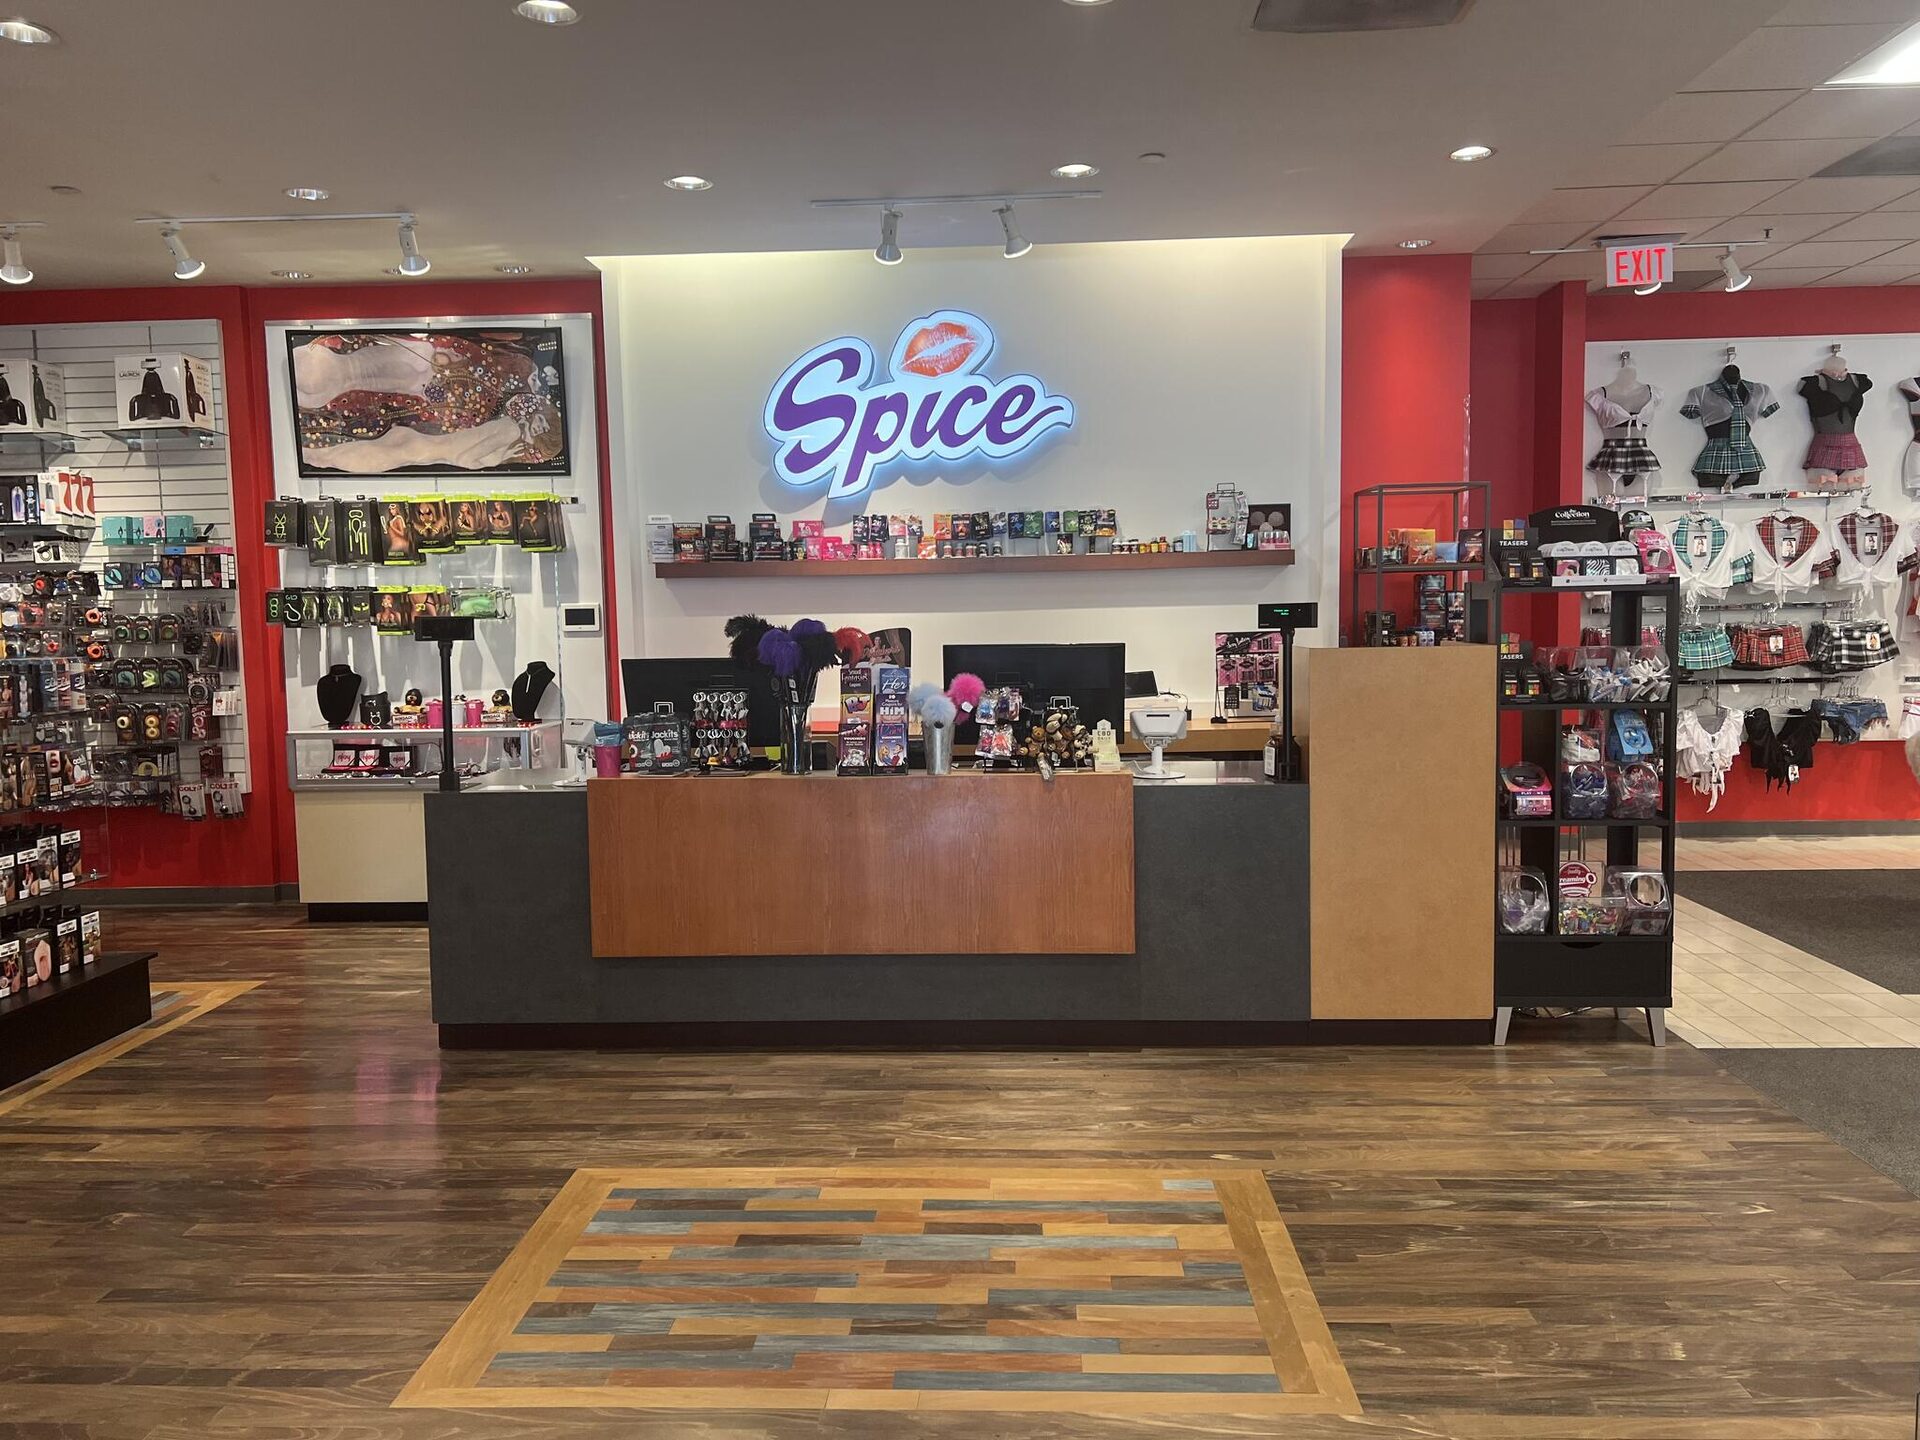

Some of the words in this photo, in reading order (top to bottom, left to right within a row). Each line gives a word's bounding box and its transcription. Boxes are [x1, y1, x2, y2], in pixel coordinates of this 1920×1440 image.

[1615, 248, 1666, 284] EXIT
[770, 344, 1067, 491] Spice
[1555, 510, 1590, 519] Collection
[882, 678, 907, 690] Her
[651, 729, 679, 739] Jackits
